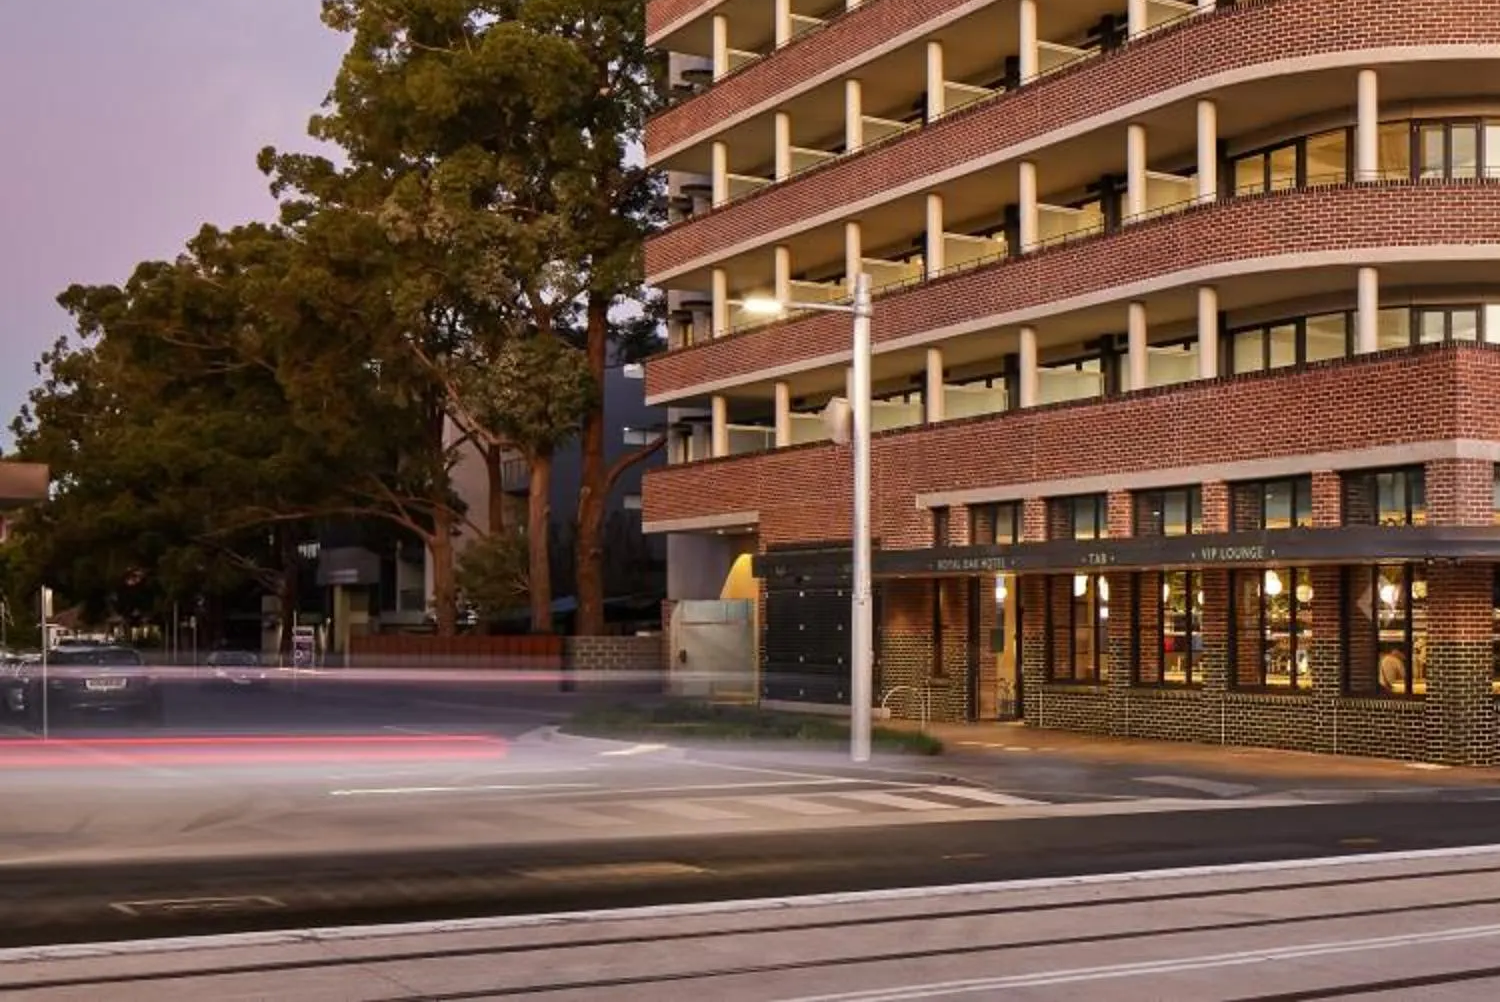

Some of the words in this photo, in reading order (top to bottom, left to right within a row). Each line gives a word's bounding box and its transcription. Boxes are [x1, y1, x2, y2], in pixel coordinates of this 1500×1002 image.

[1202, 547, 1217, 559] VIP
[1219, 545, 1264, 559] LOUNGE
[1088, 553, 1107, 565] TAB
